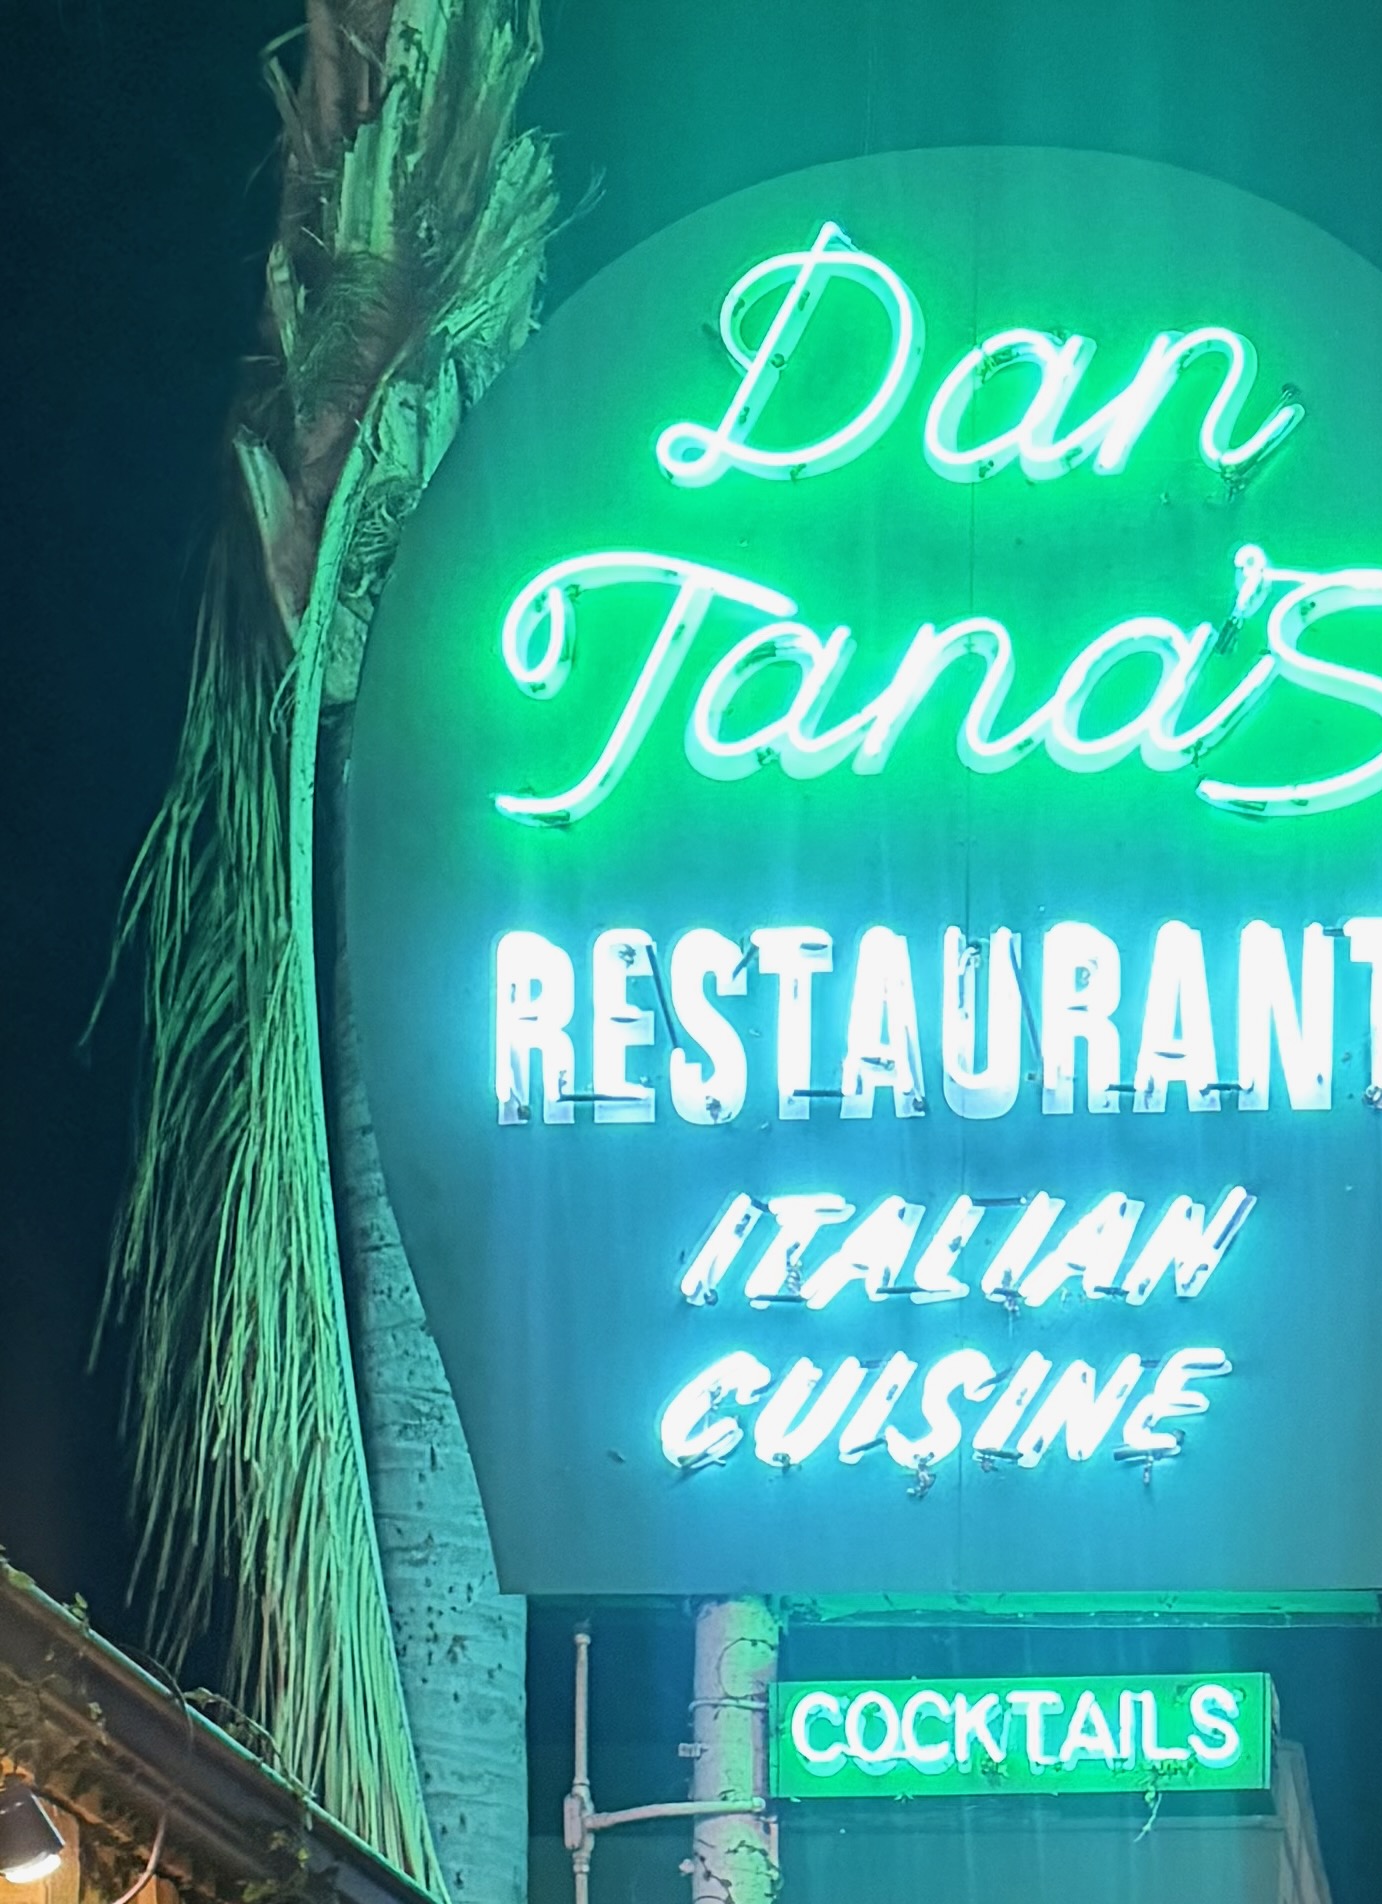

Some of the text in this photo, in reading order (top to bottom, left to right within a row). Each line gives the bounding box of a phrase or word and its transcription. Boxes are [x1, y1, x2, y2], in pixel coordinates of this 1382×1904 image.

[658, 222, 1304, 486] Dan
[680, 1184, 1255, 1308] ITALIAN
[660, 1348, 1233, 1470] CUISINE
[790, 1684, 1240, 1772] COCKTAILS
